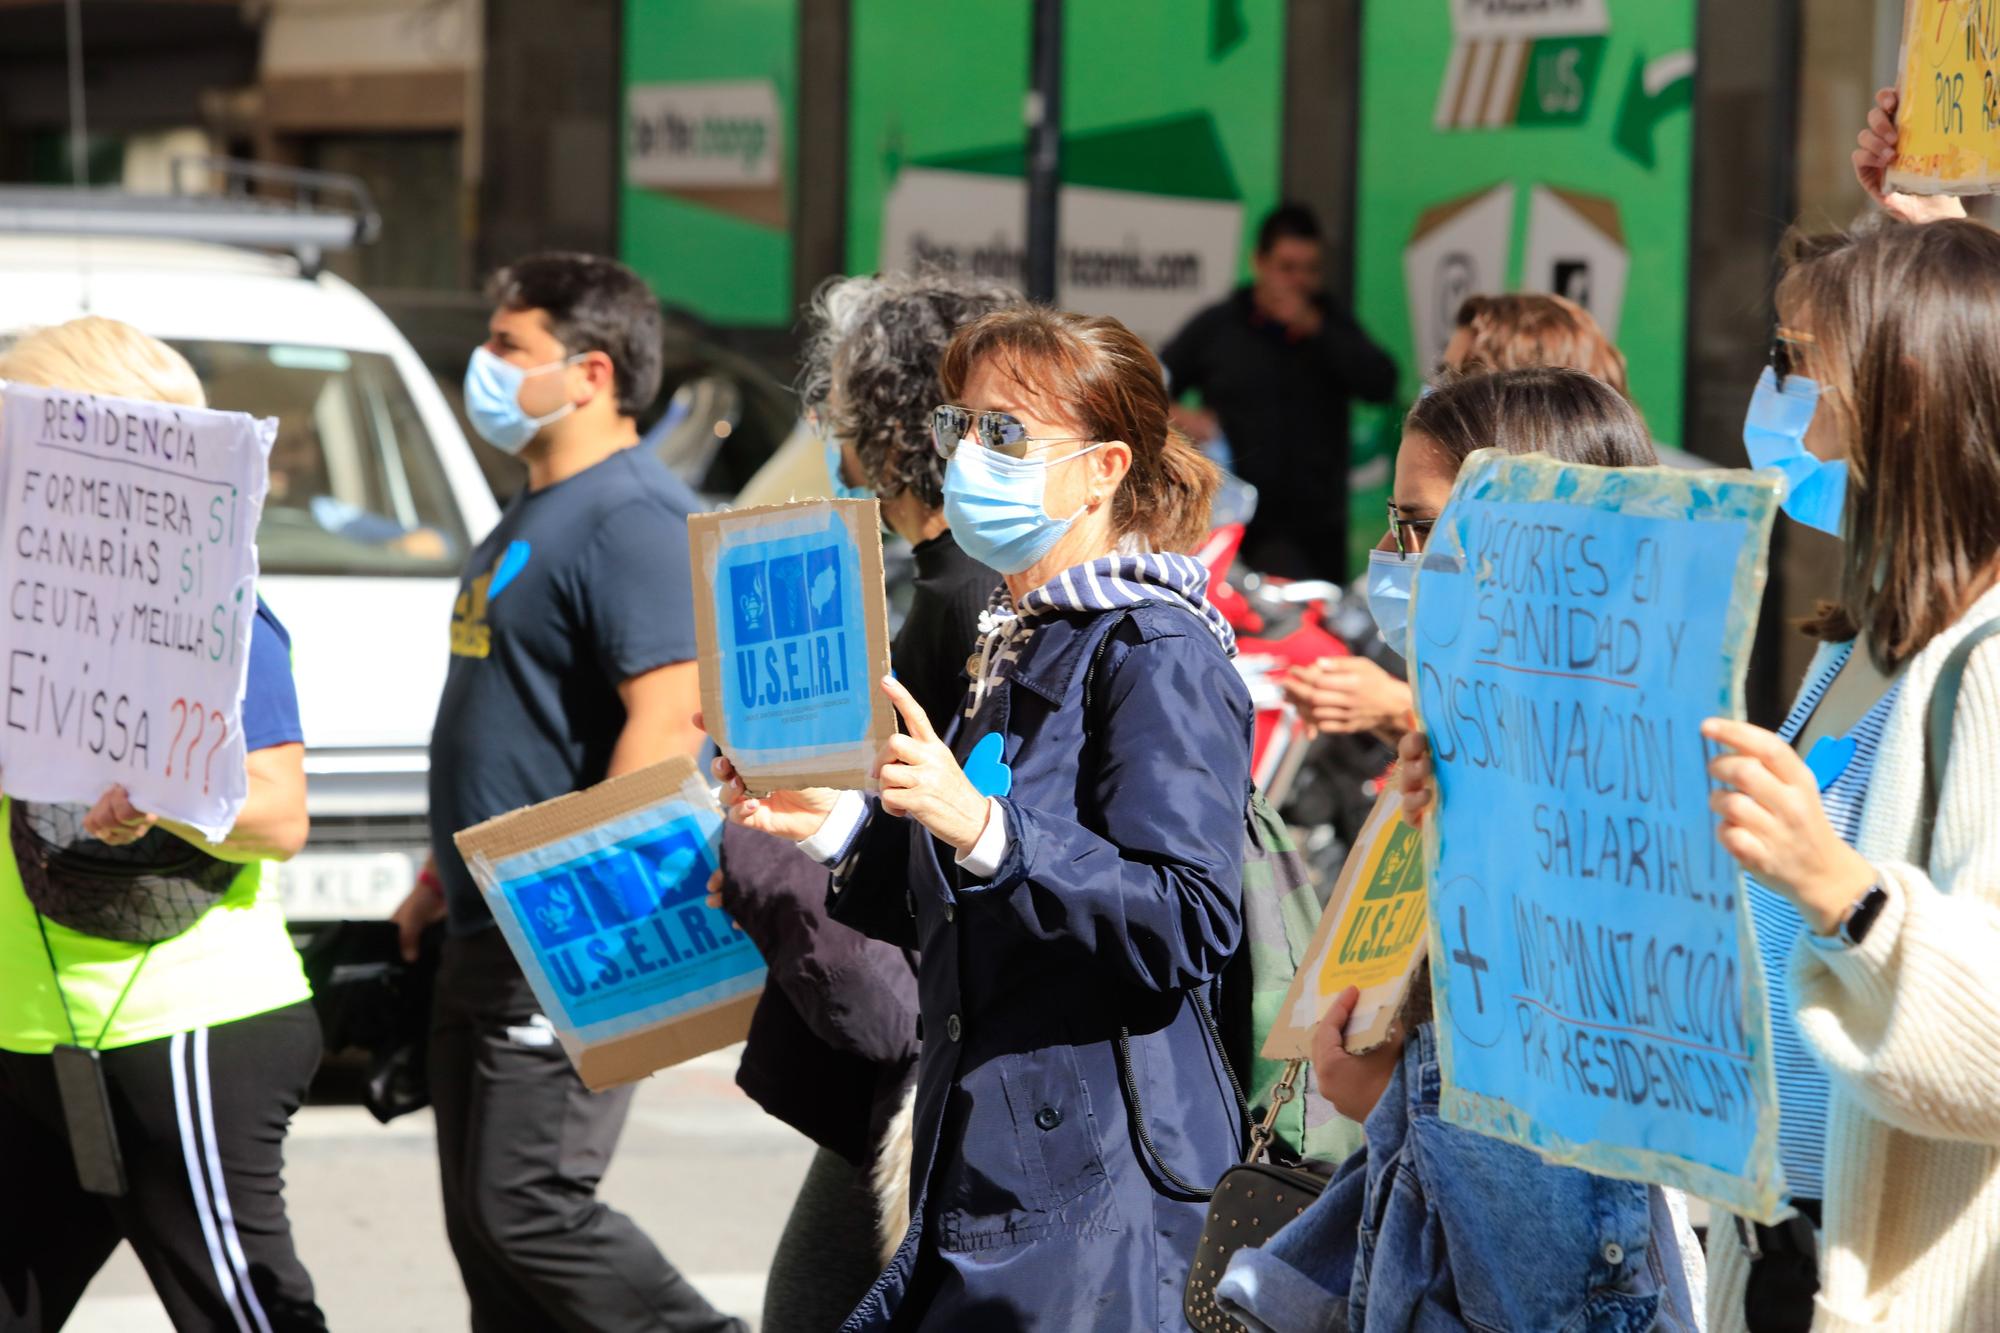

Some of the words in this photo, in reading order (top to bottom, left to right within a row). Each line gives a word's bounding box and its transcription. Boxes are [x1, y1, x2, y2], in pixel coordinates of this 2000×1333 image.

[1934, 71, 1964, 134] POR
[22, 470, 193, 537] FORMENTERA
[11, 578, 100, 640] CEUTA
[1477, 593, 1643, 678] SANIDAD
[164, 696, 229, 796] ???
